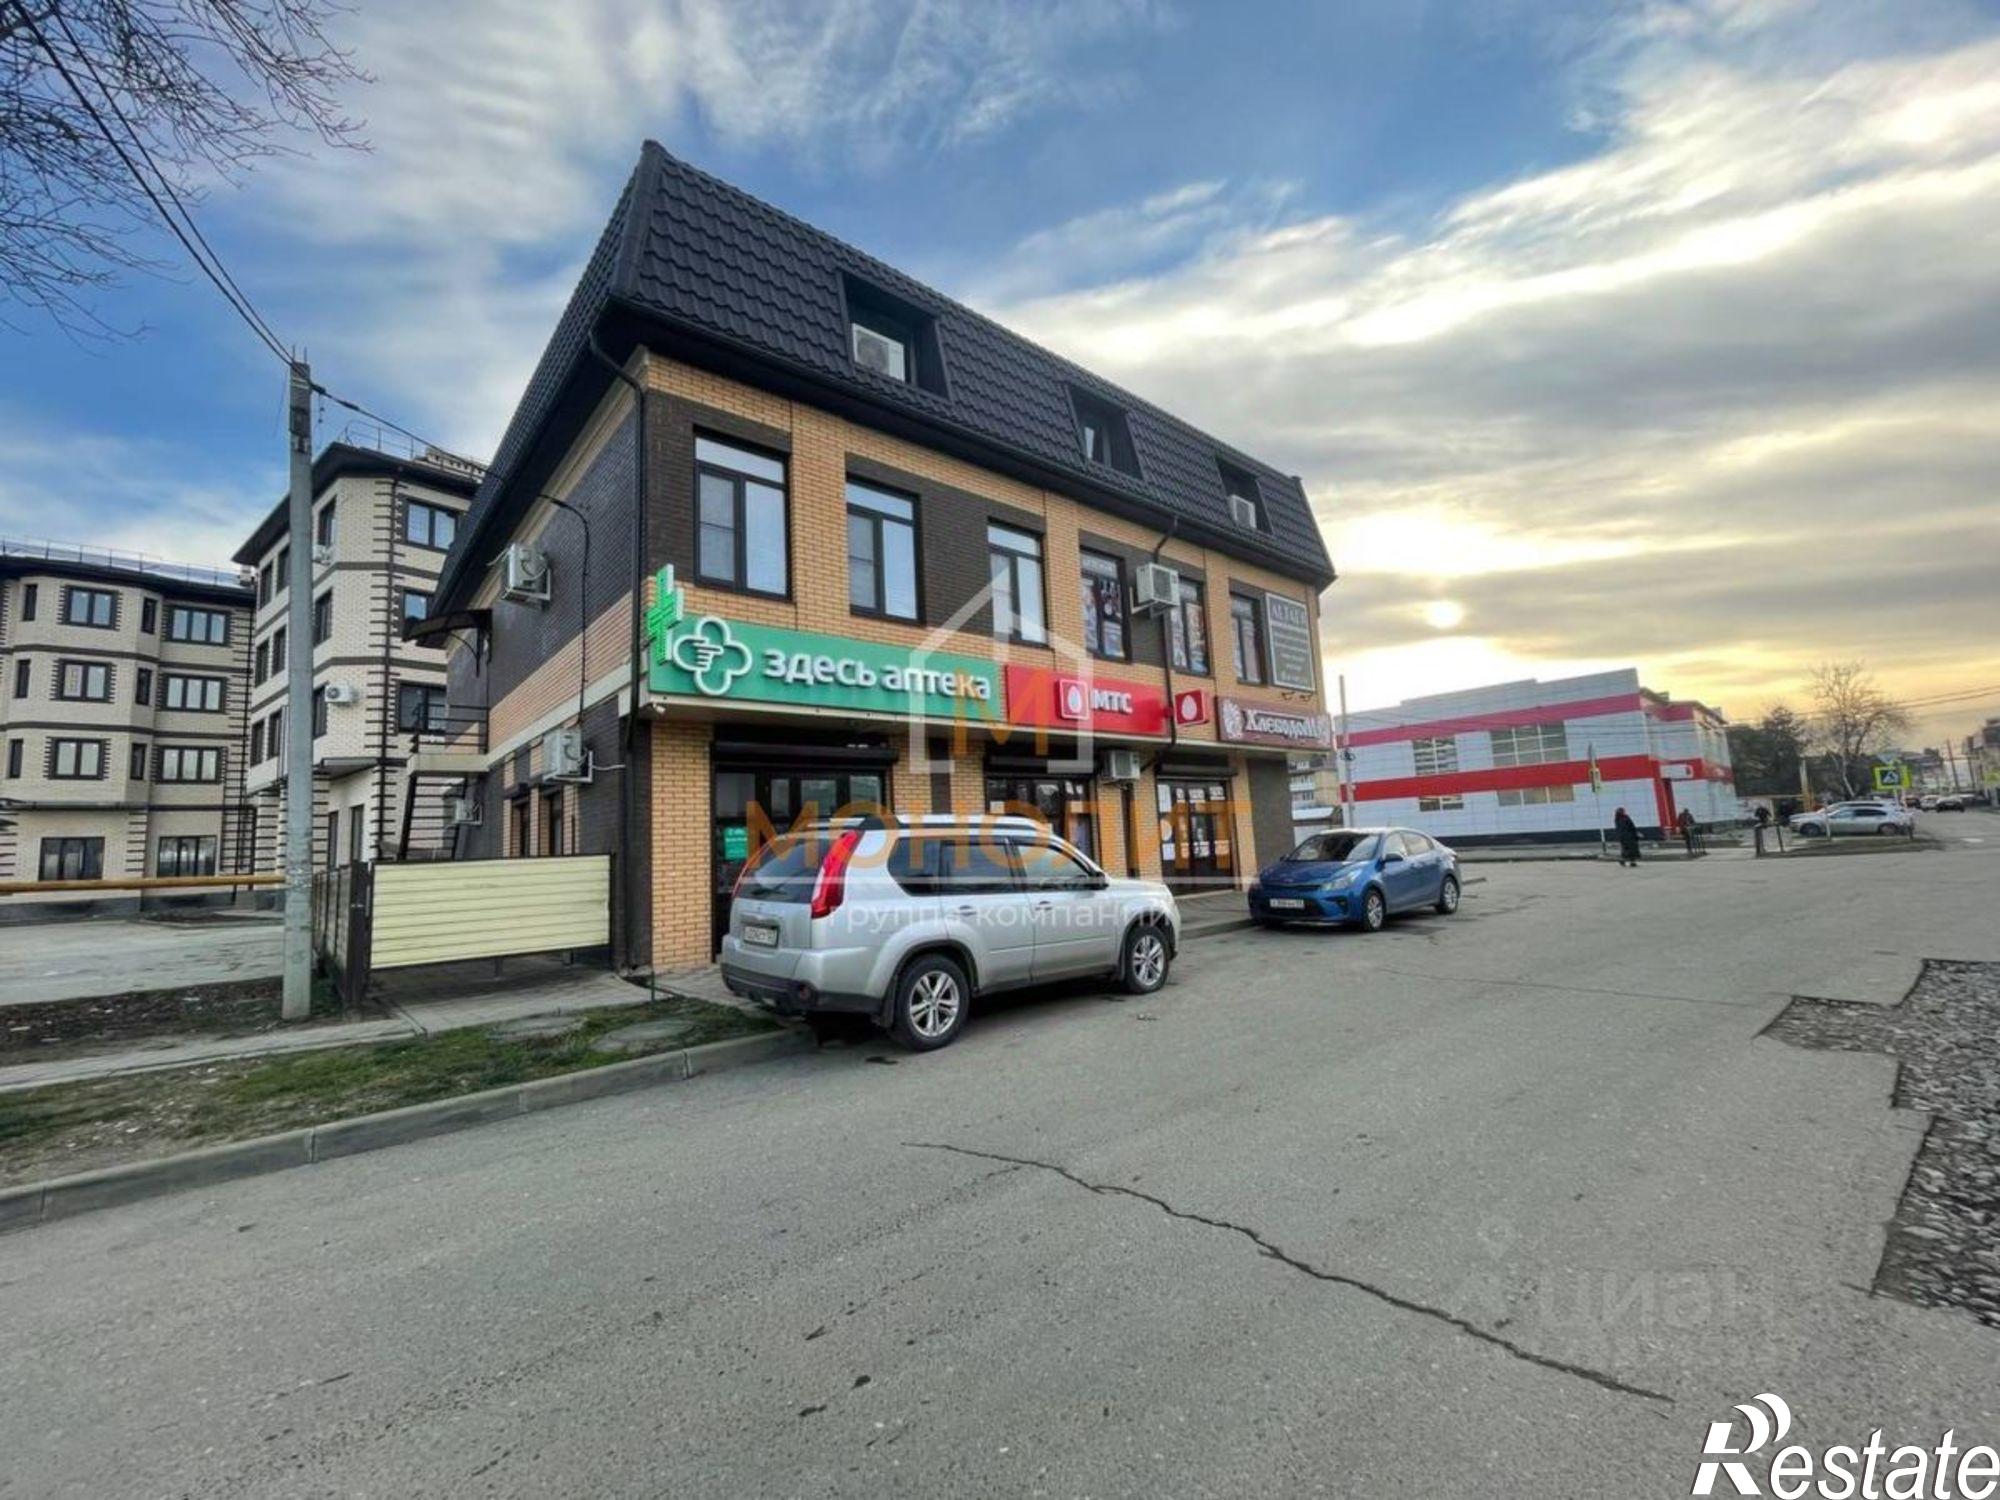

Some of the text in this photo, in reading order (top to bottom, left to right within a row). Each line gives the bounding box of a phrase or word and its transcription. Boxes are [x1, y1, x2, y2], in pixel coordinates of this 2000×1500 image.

[763, 647, 991, 701] здесь аптека
[1092, 689, 1133, 713] МТС
